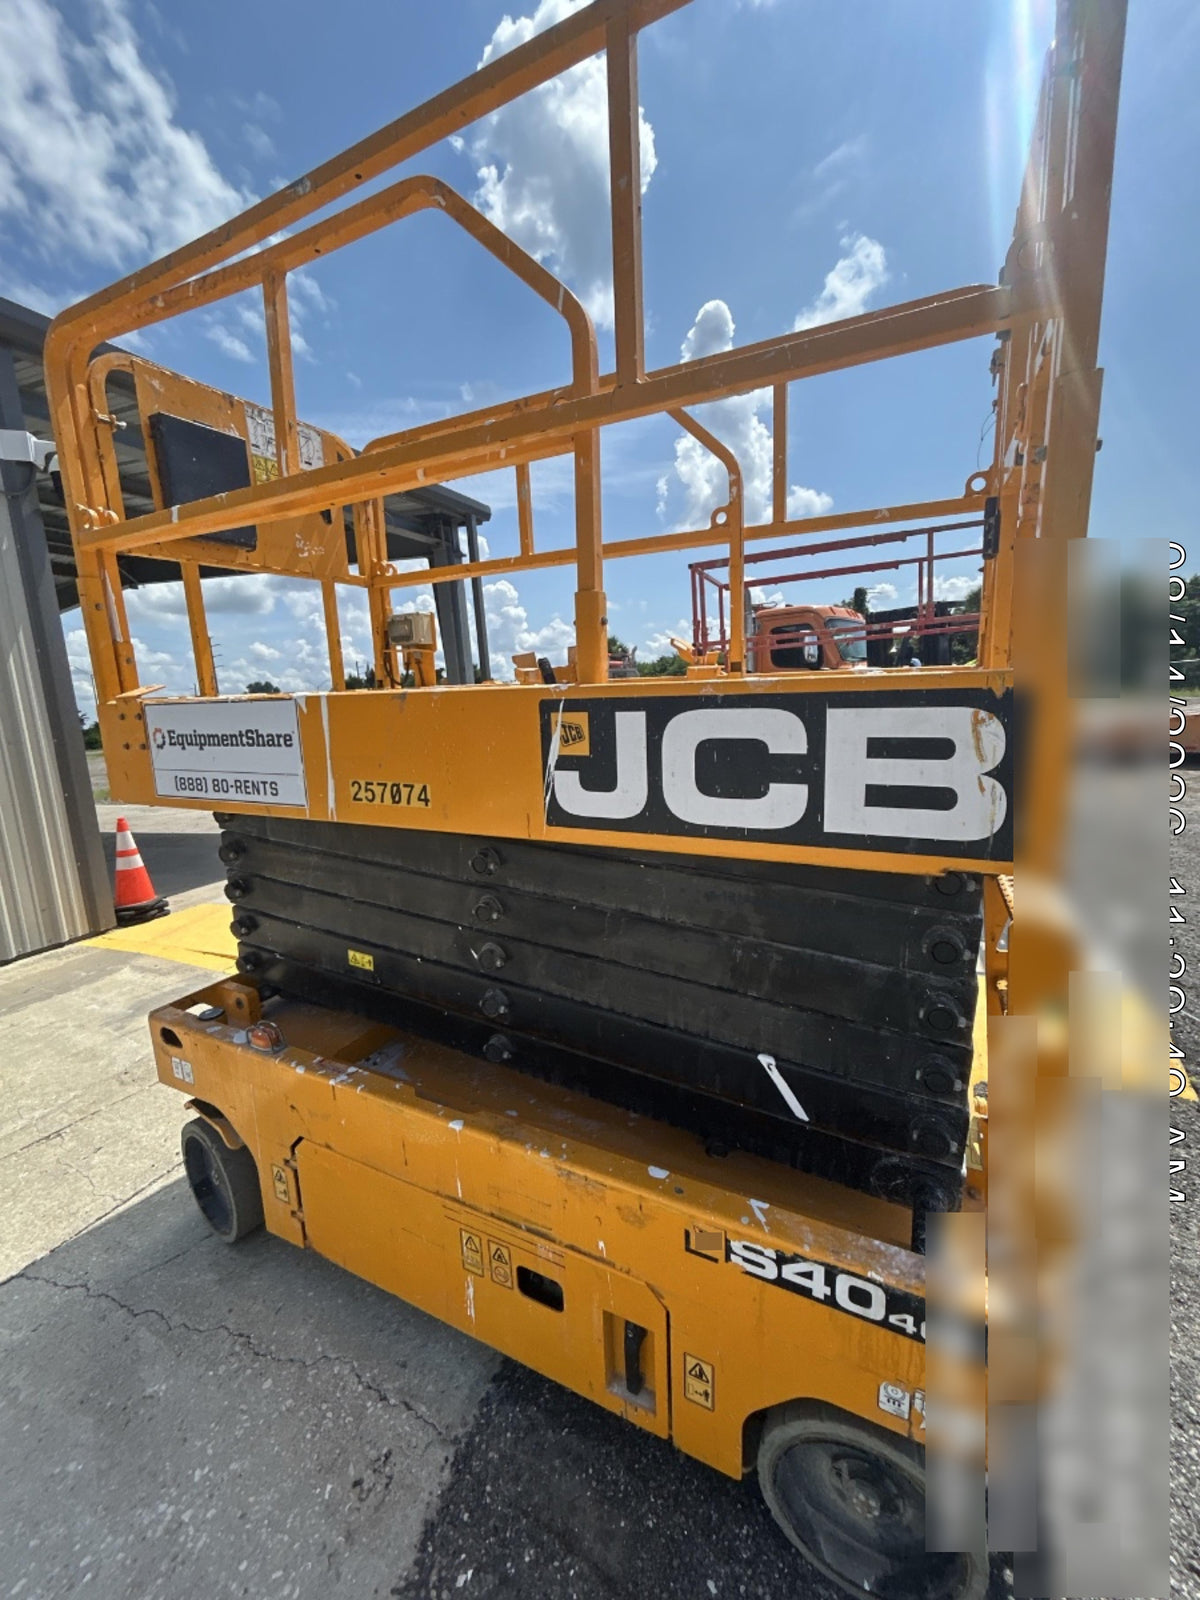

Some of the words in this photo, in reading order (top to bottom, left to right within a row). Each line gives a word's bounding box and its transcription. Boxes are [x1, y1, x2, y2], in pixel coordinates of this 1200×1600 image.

[167, 729, 293, 750] EquipmentShare
[560, 722, 584, 745] JCB
[553, 706, 1007, 841] JCB
[174, 775, 208, 794] (888)
[212, 778, 279, 797] 80-RENTS
[351, 781, 430, 807] 257074
